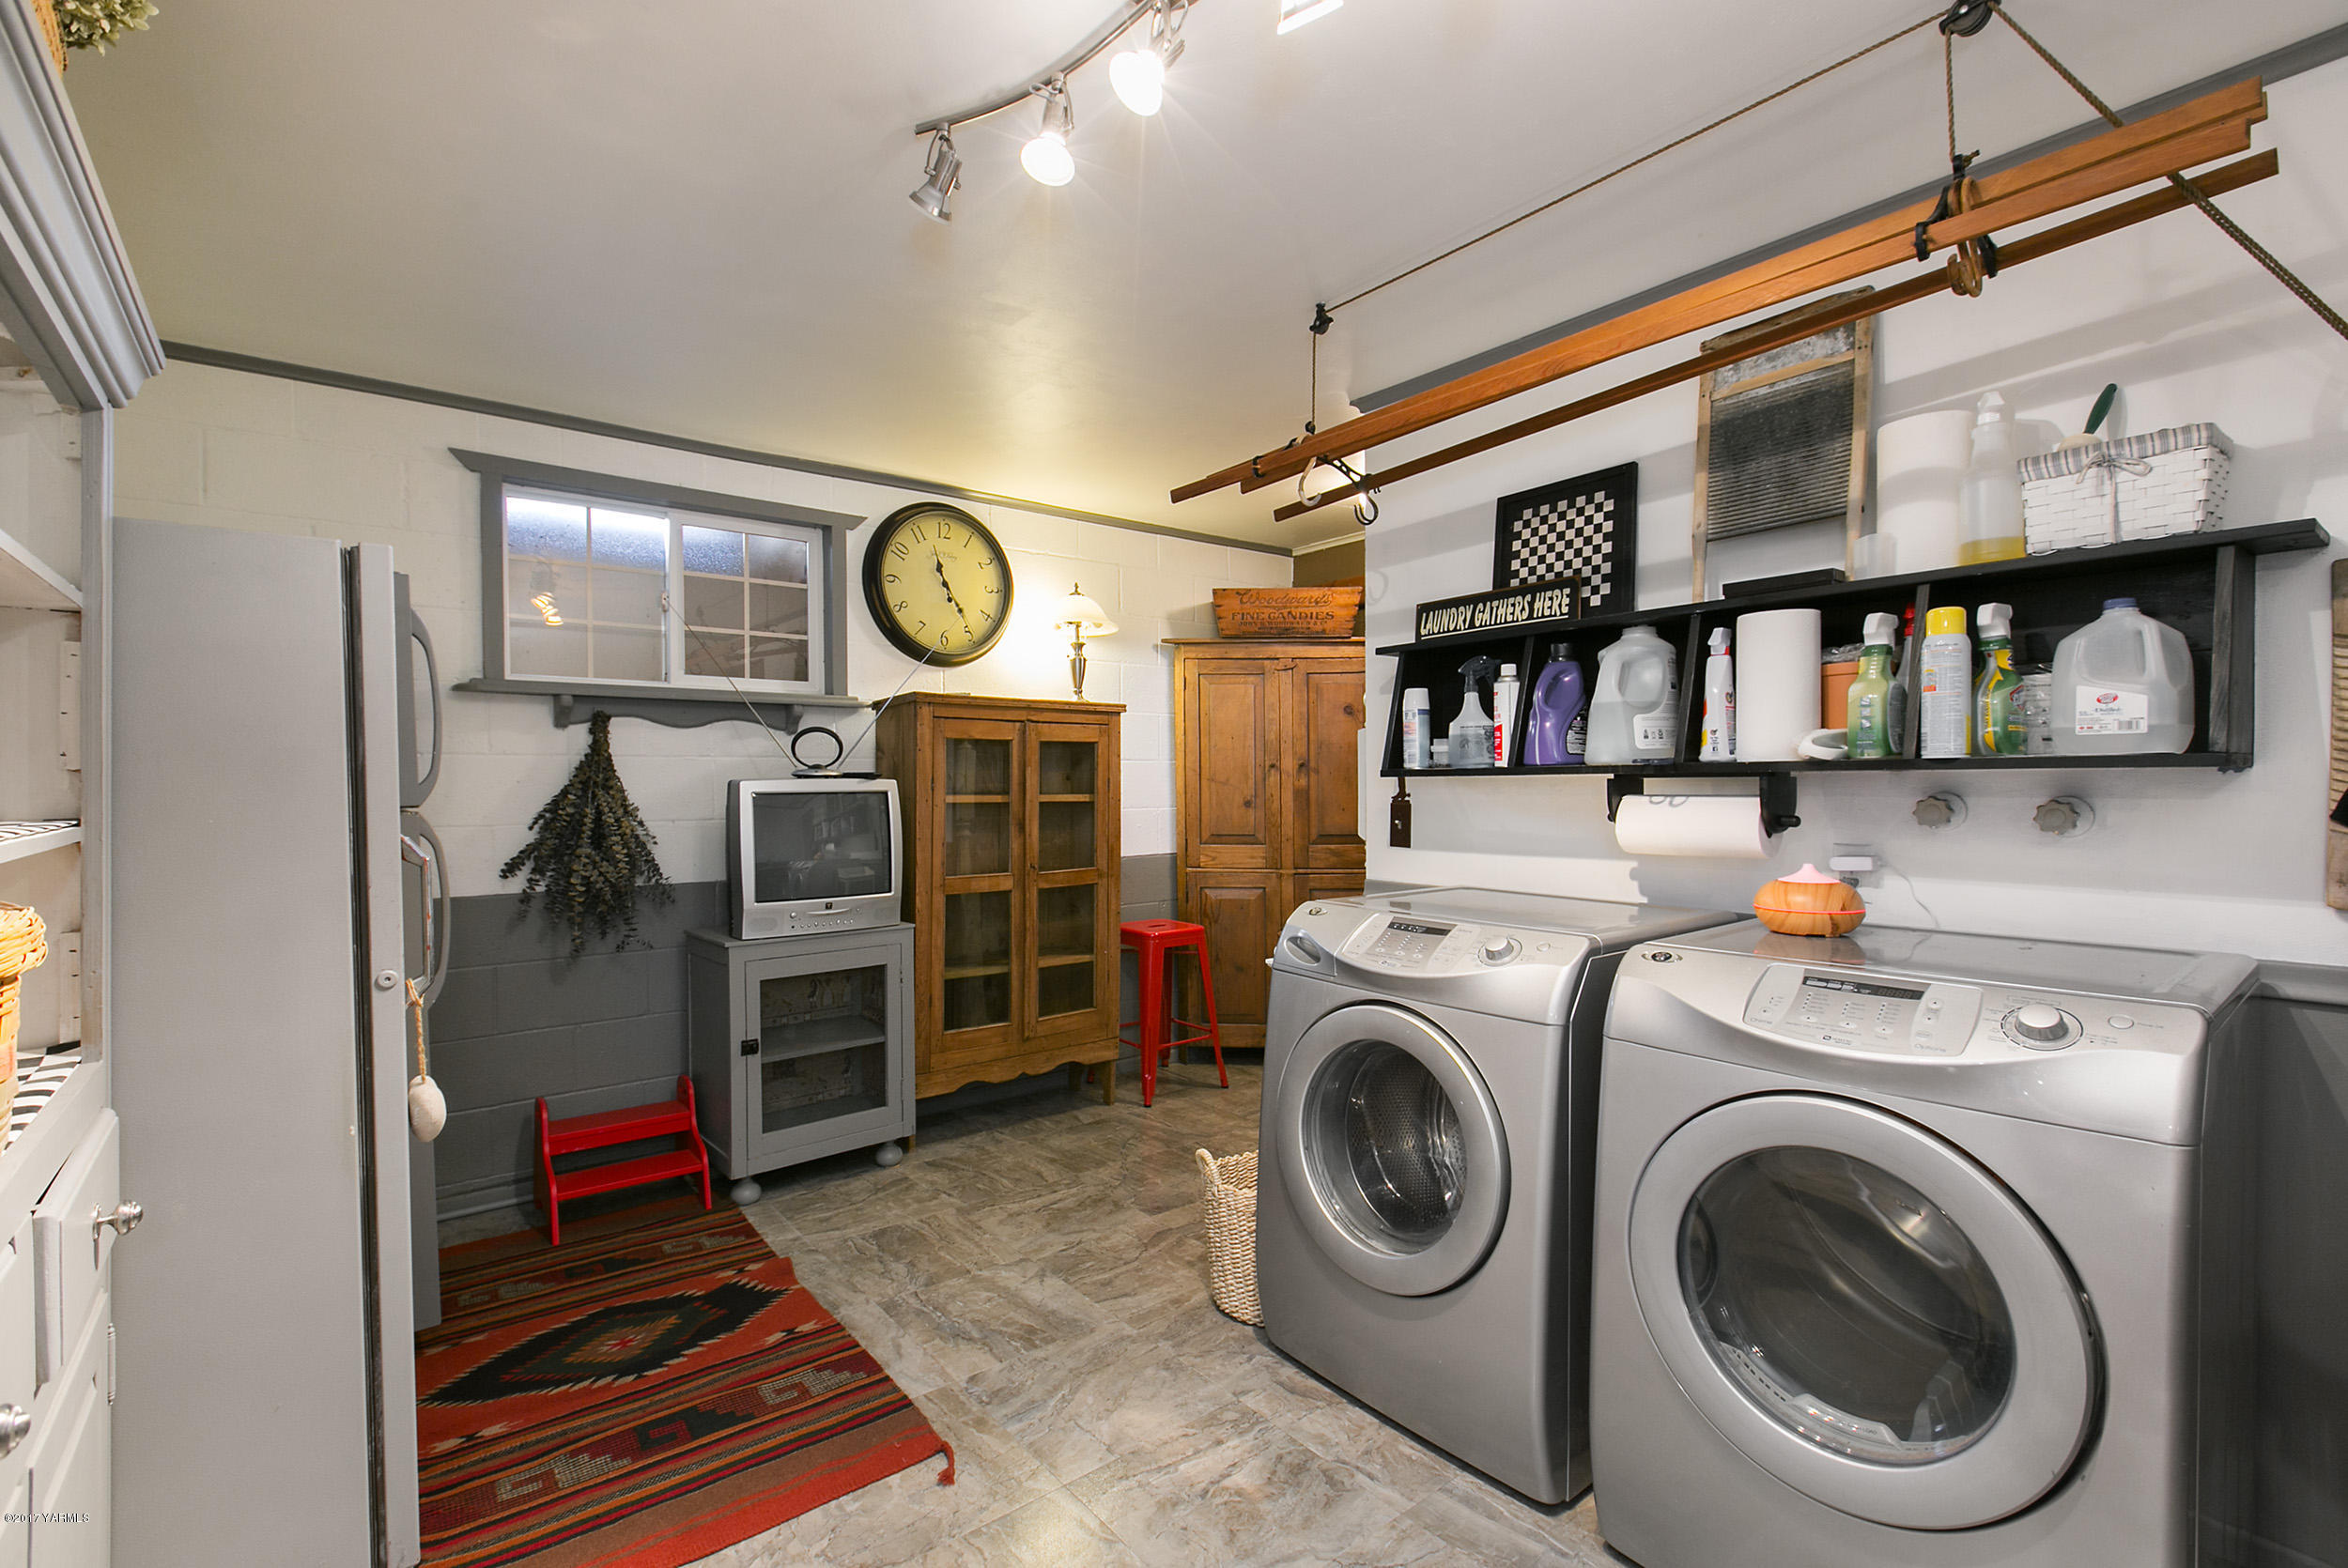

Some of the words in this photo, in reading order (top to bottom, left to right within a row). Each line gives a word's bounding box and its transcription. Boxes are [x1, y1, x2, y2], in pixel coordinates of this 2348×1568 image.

[910, 525, 927, 544] 11
[937, 522, 951, 540] 12
[964, 534, 973, 548] 1
[890, 542, 910, 561] 10
[978, 557, 993, 570] 2
[885, 574, 902, 583] 9
[984, 585, 999, 594] 3
[893, 601, 908, 613] 8
[1420, 604, 1474, 636] LAUNDRY
[1475, 593, 1532, 627] GATHERS
[1534, 588, 1571, 618] HERE
[980, 609, 993, 622] 4
[1231, 611, 1265, 621] FINE
[915, 621, 926, 636] 7
[964, 625, 974, 642] 5
[940, 630, 949, 647] 6
